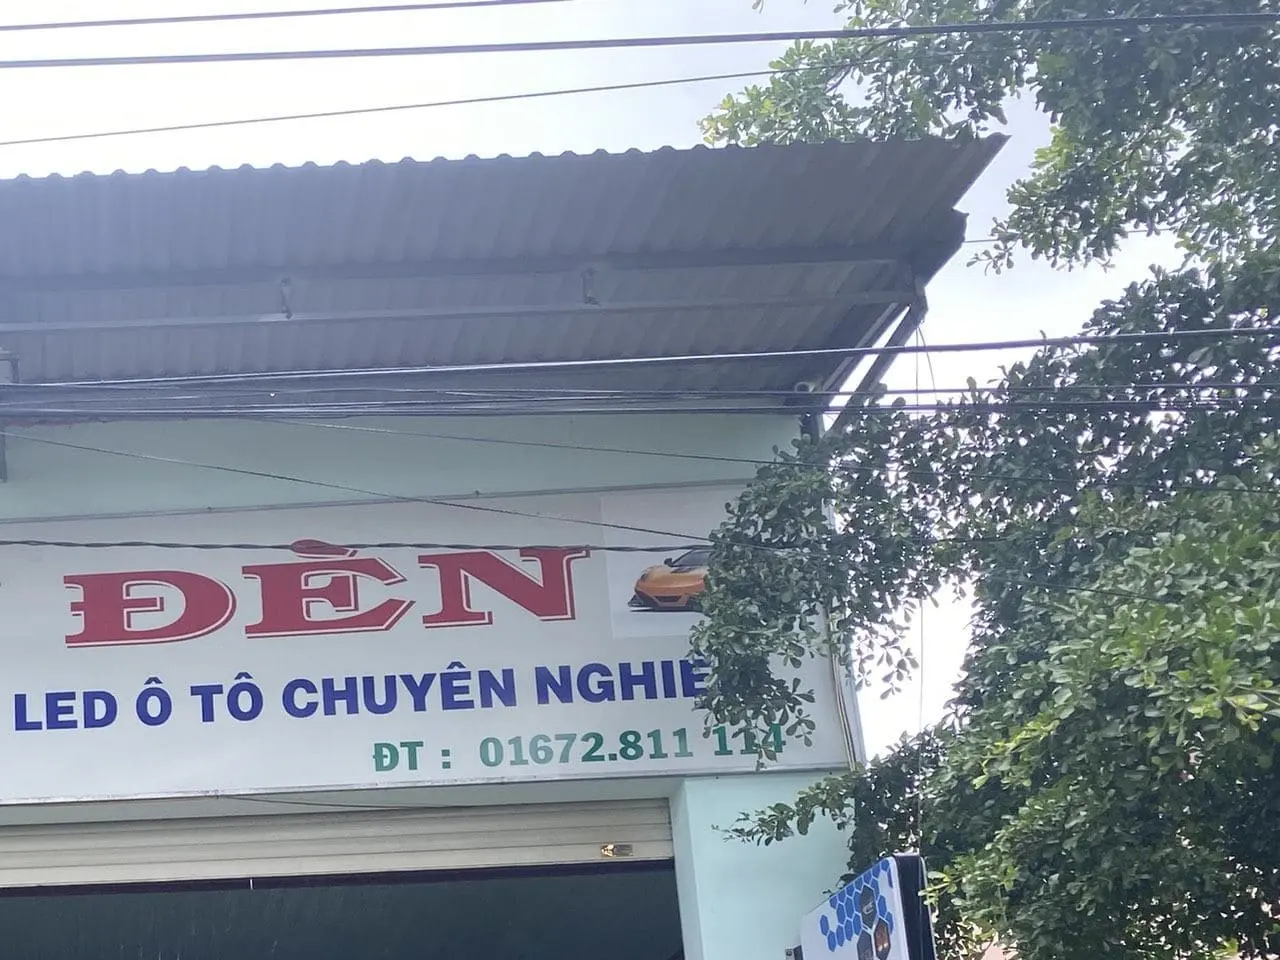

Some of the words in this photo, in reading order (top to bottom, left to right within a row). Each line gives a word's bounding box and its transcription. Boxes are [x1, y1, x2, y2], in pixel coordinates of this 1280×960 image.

[65, 539, 592, 650] ĐÈN
[15, 689, 118, 731] LED
[135, 676, 173, 727] Ô
[191, 672, 263, 723] TÔ
[282, 662, 519, 717] CHUYÊN
[373, 741, 423, 772] ĐT
[479, 727, 694, 769] 01672.811
